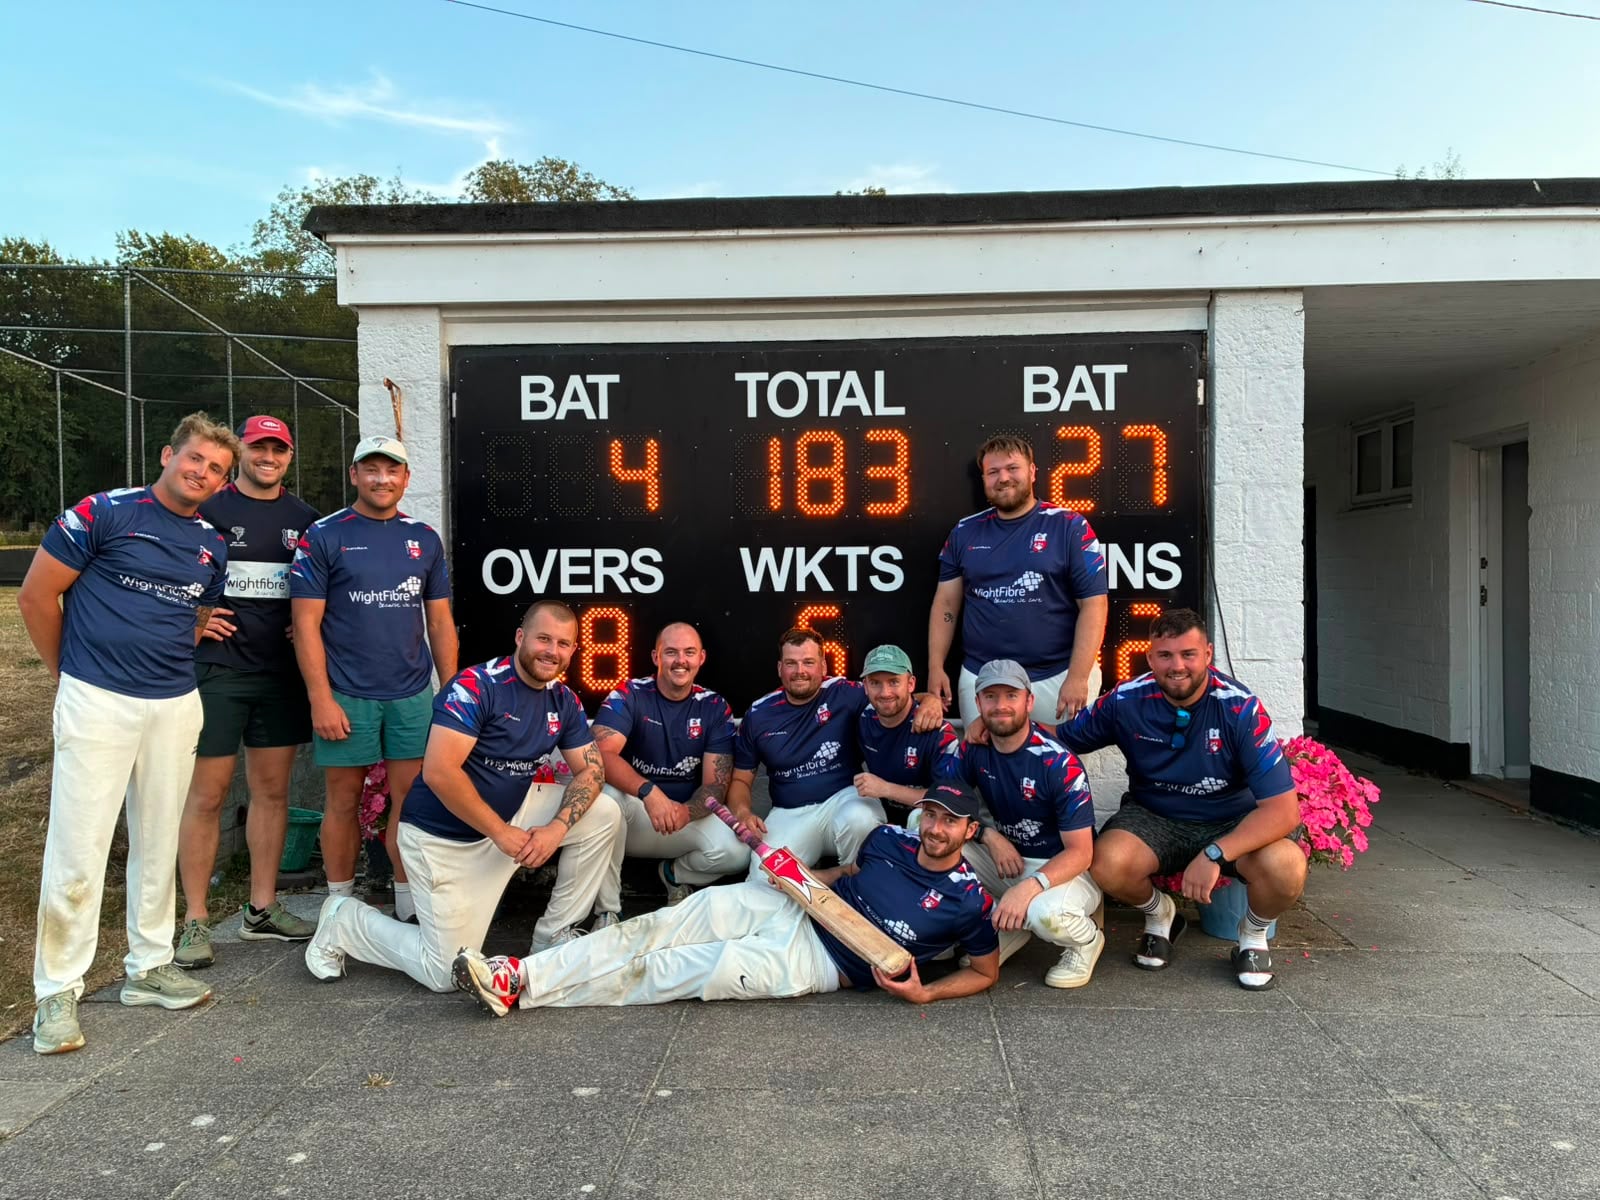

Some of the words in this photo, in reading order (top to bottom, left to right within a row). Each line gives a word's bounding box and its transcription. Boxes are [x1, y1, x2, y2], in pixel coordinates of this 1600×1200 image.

[520, 374, 620, 421] BAT
[734, 370, 906, 418] TOTAL
[1022, 364, 1128, 413] BAT
[609, 437, 660, 513] 4
[767, 429, 910, 516] 183
[1049, 424, 1168, 513] 27
[481, 547, 665, 594] OVERS
[739, 545, 905, 593] WKTS
[348, 589, 410, 605] WightFibre
[554, 606, 630, 691] 8
